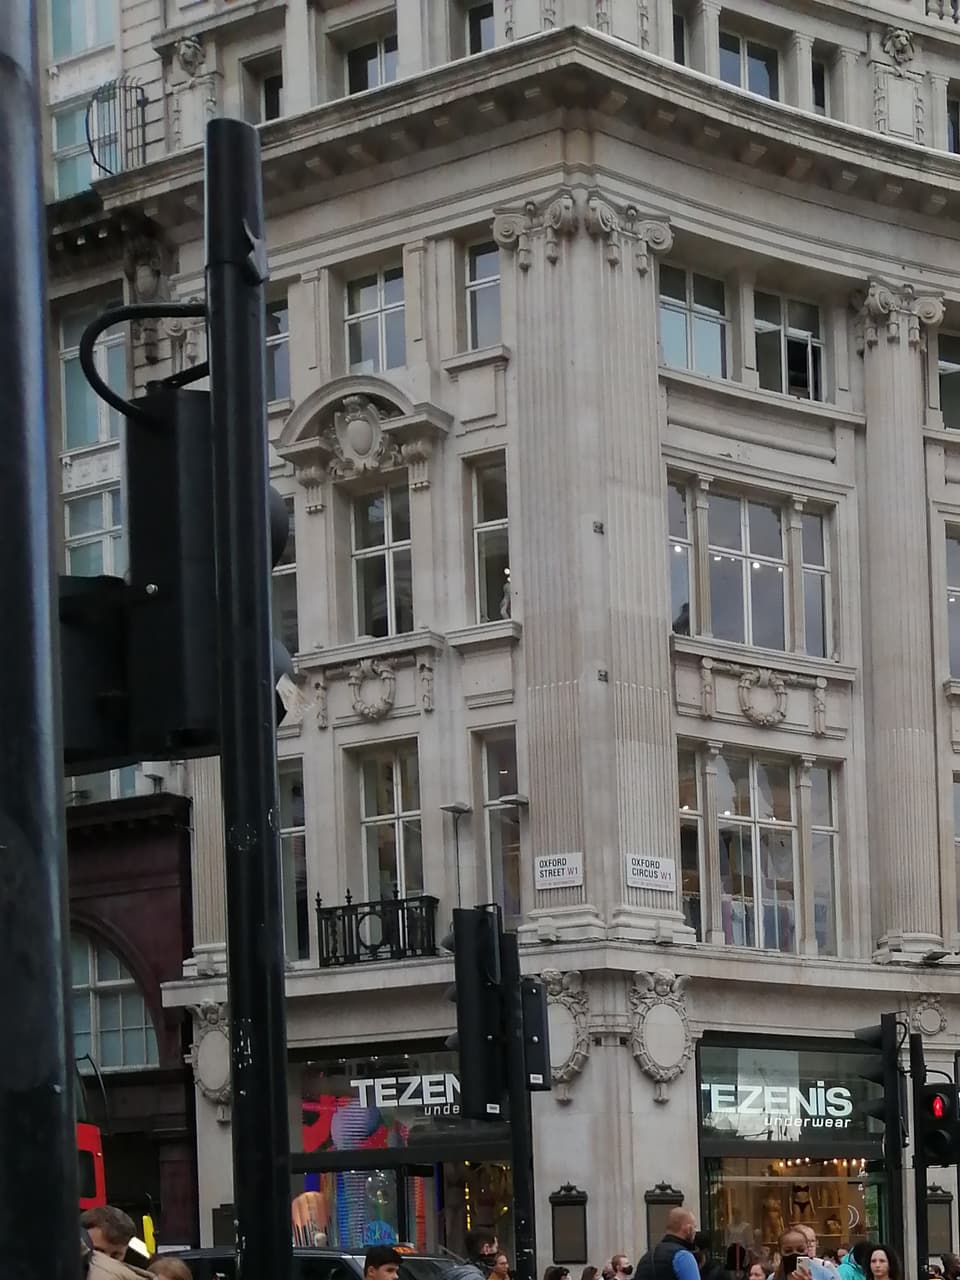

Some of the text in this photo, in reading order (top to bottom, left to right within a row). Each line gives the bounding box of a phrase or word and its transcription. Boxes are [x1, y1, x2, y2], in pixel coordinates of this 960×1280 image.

[539, 857, 567, 868] OXFORD
[631, 857, 660, 869] OXFORD
[539, 866, 578, 878] STREET W1
[631, 867, 672, 880] CIRCUS W1
[350, 1073, 461, 1108] TEZEN
[764, 1117, 851, 1128] underwear
